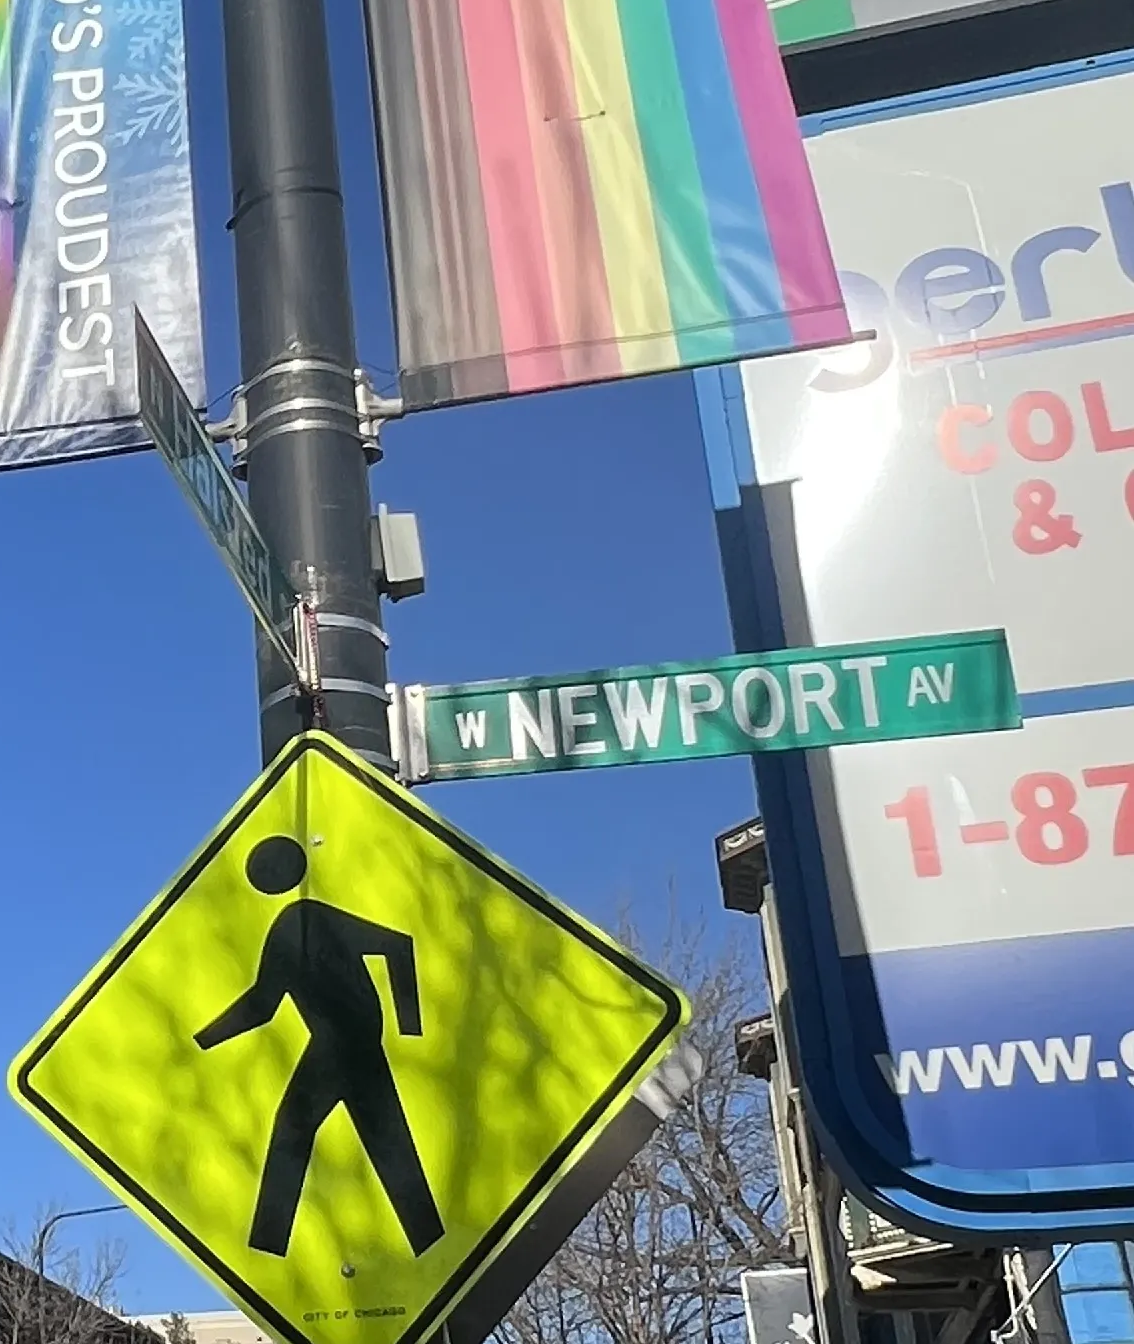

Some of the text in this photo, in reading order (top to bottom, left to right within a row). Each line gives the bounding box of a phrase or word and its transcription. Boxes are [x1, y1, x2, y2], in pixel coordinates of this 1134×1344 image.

[53, 67, 116, 387] PROUDEST
[807, 182, 1134, 393] ger
[937, 381, 1134, 474] COL
[1013, 479, 1083, 555] &
[455, 656, 956, 761] W NEWPORT AV
[884, 763, 1134, 878] 1-87
